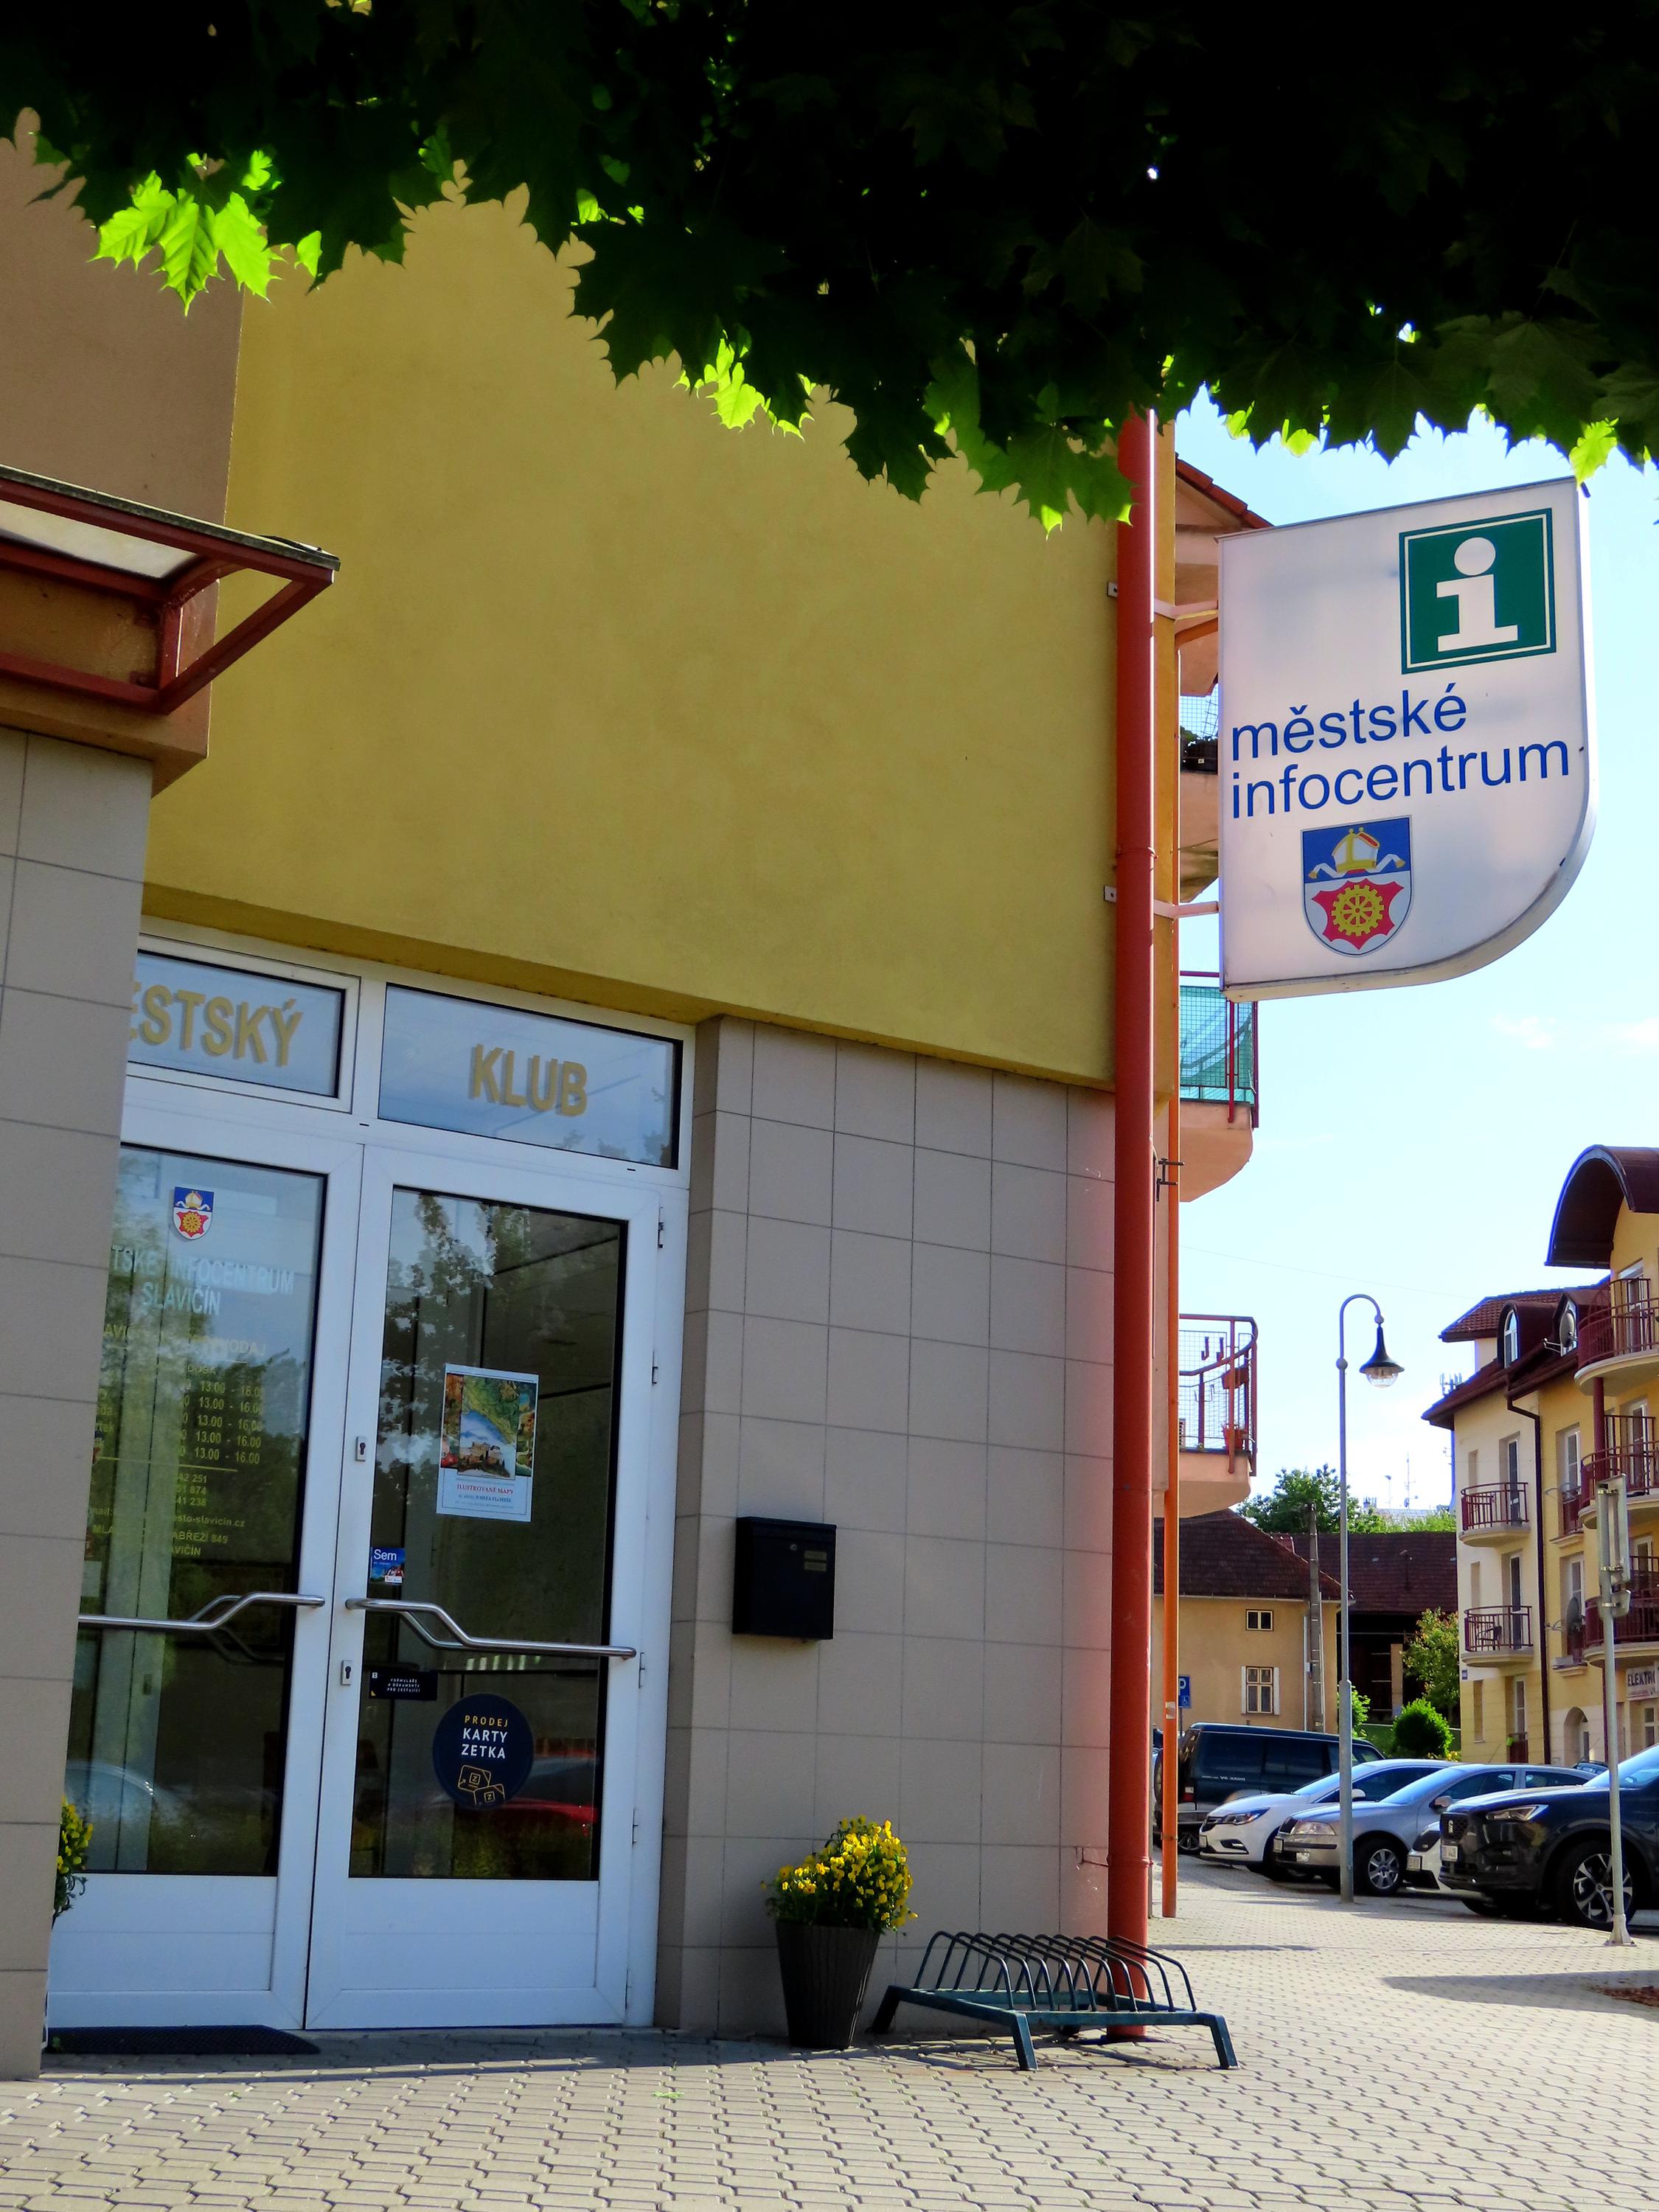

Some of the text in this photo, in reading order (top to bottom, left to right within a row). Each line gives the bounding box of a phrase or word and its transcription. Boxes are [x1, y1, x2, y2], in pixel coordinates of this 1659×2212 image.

[1232, 682, 1467, 761] městské
[1233, 740, 1569, 818] infocentrum
[130, 981, 588, 1116] STSKÝ KLUB
[141, 1281, 221, 1316] SLAVIČÍN
[200, 1380, 226, 1394] 13.00
[198, 1397, 225, 1410] 13.00
[197, 1414, 223, 1427] 13.00
[195, 1430, 221, 1444] 13.00
[195, 1447, 220, 1460] 13.00
[373, 1548, 397, 1561] Sem
[1178, 1677, 1187, 1696] P
[465, 1715, 508, 1728] PRODEJ
[462, 1728, 508, 1743] KARTY
[461, 1744, 507, 1759] ZETKA
